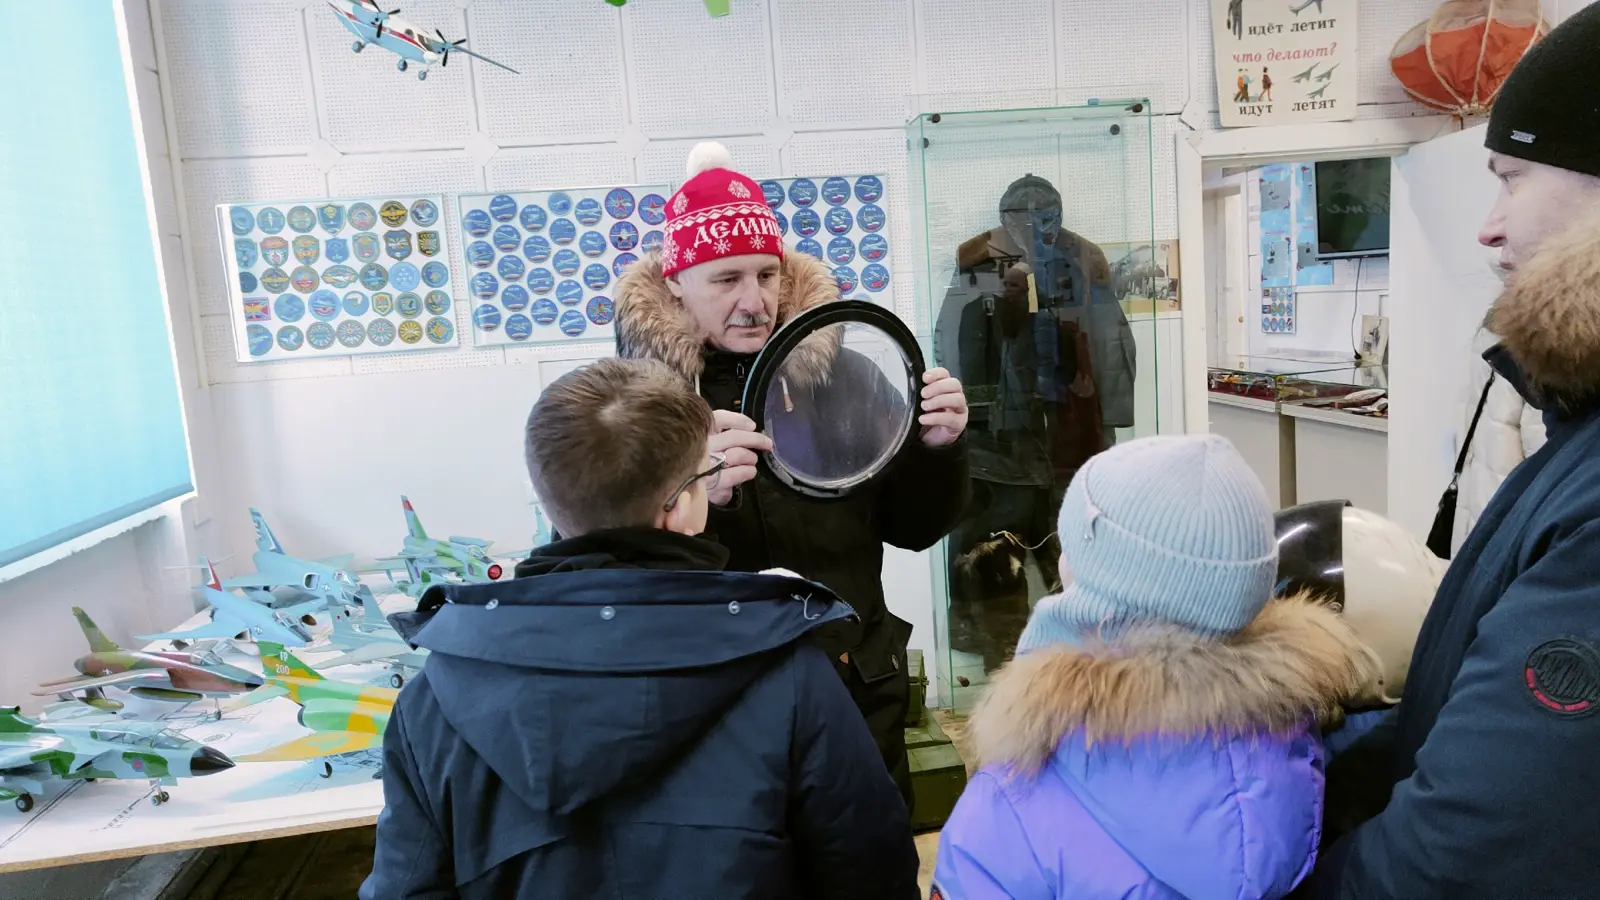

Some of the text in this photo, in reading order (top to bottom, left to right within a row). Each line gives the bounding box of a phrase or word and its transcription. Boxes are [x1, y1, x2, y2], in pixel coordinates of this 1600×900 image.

[1248, 18, 1336, 36] идёт летит
[1232, 42, 1337, 63] что делают?
[1239, 98, 1337, 116] идут летят
[275, 663, 290, 674] 200
